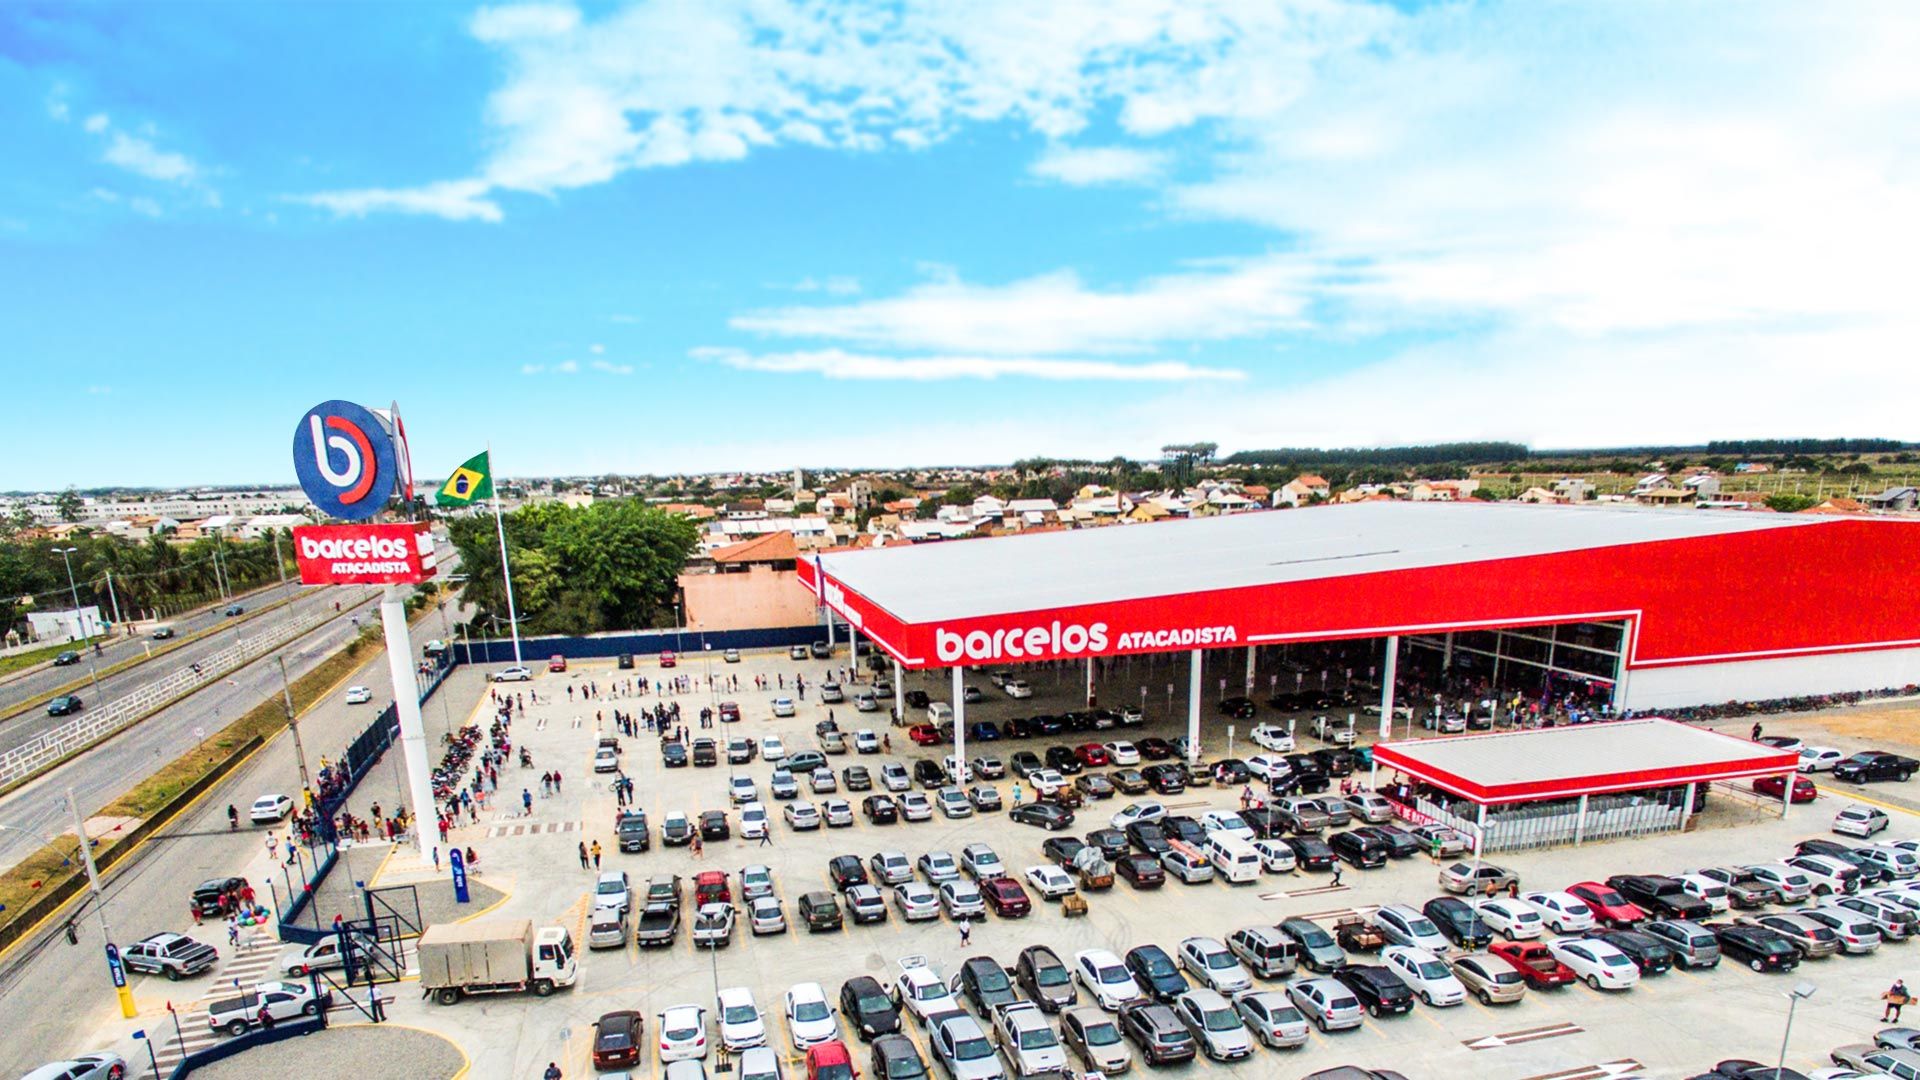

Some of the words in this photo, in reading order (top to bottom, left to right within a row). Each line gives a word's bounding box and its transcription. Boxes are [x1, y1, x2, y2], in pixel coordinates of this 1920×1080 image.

[301, 535, 409, 560] barcelos
[331, 561, 411, 575] ATACADISTA
[936, 621, 1109, 662] barcelos
[1117, 626, 1237, 650] ATACADISTA
